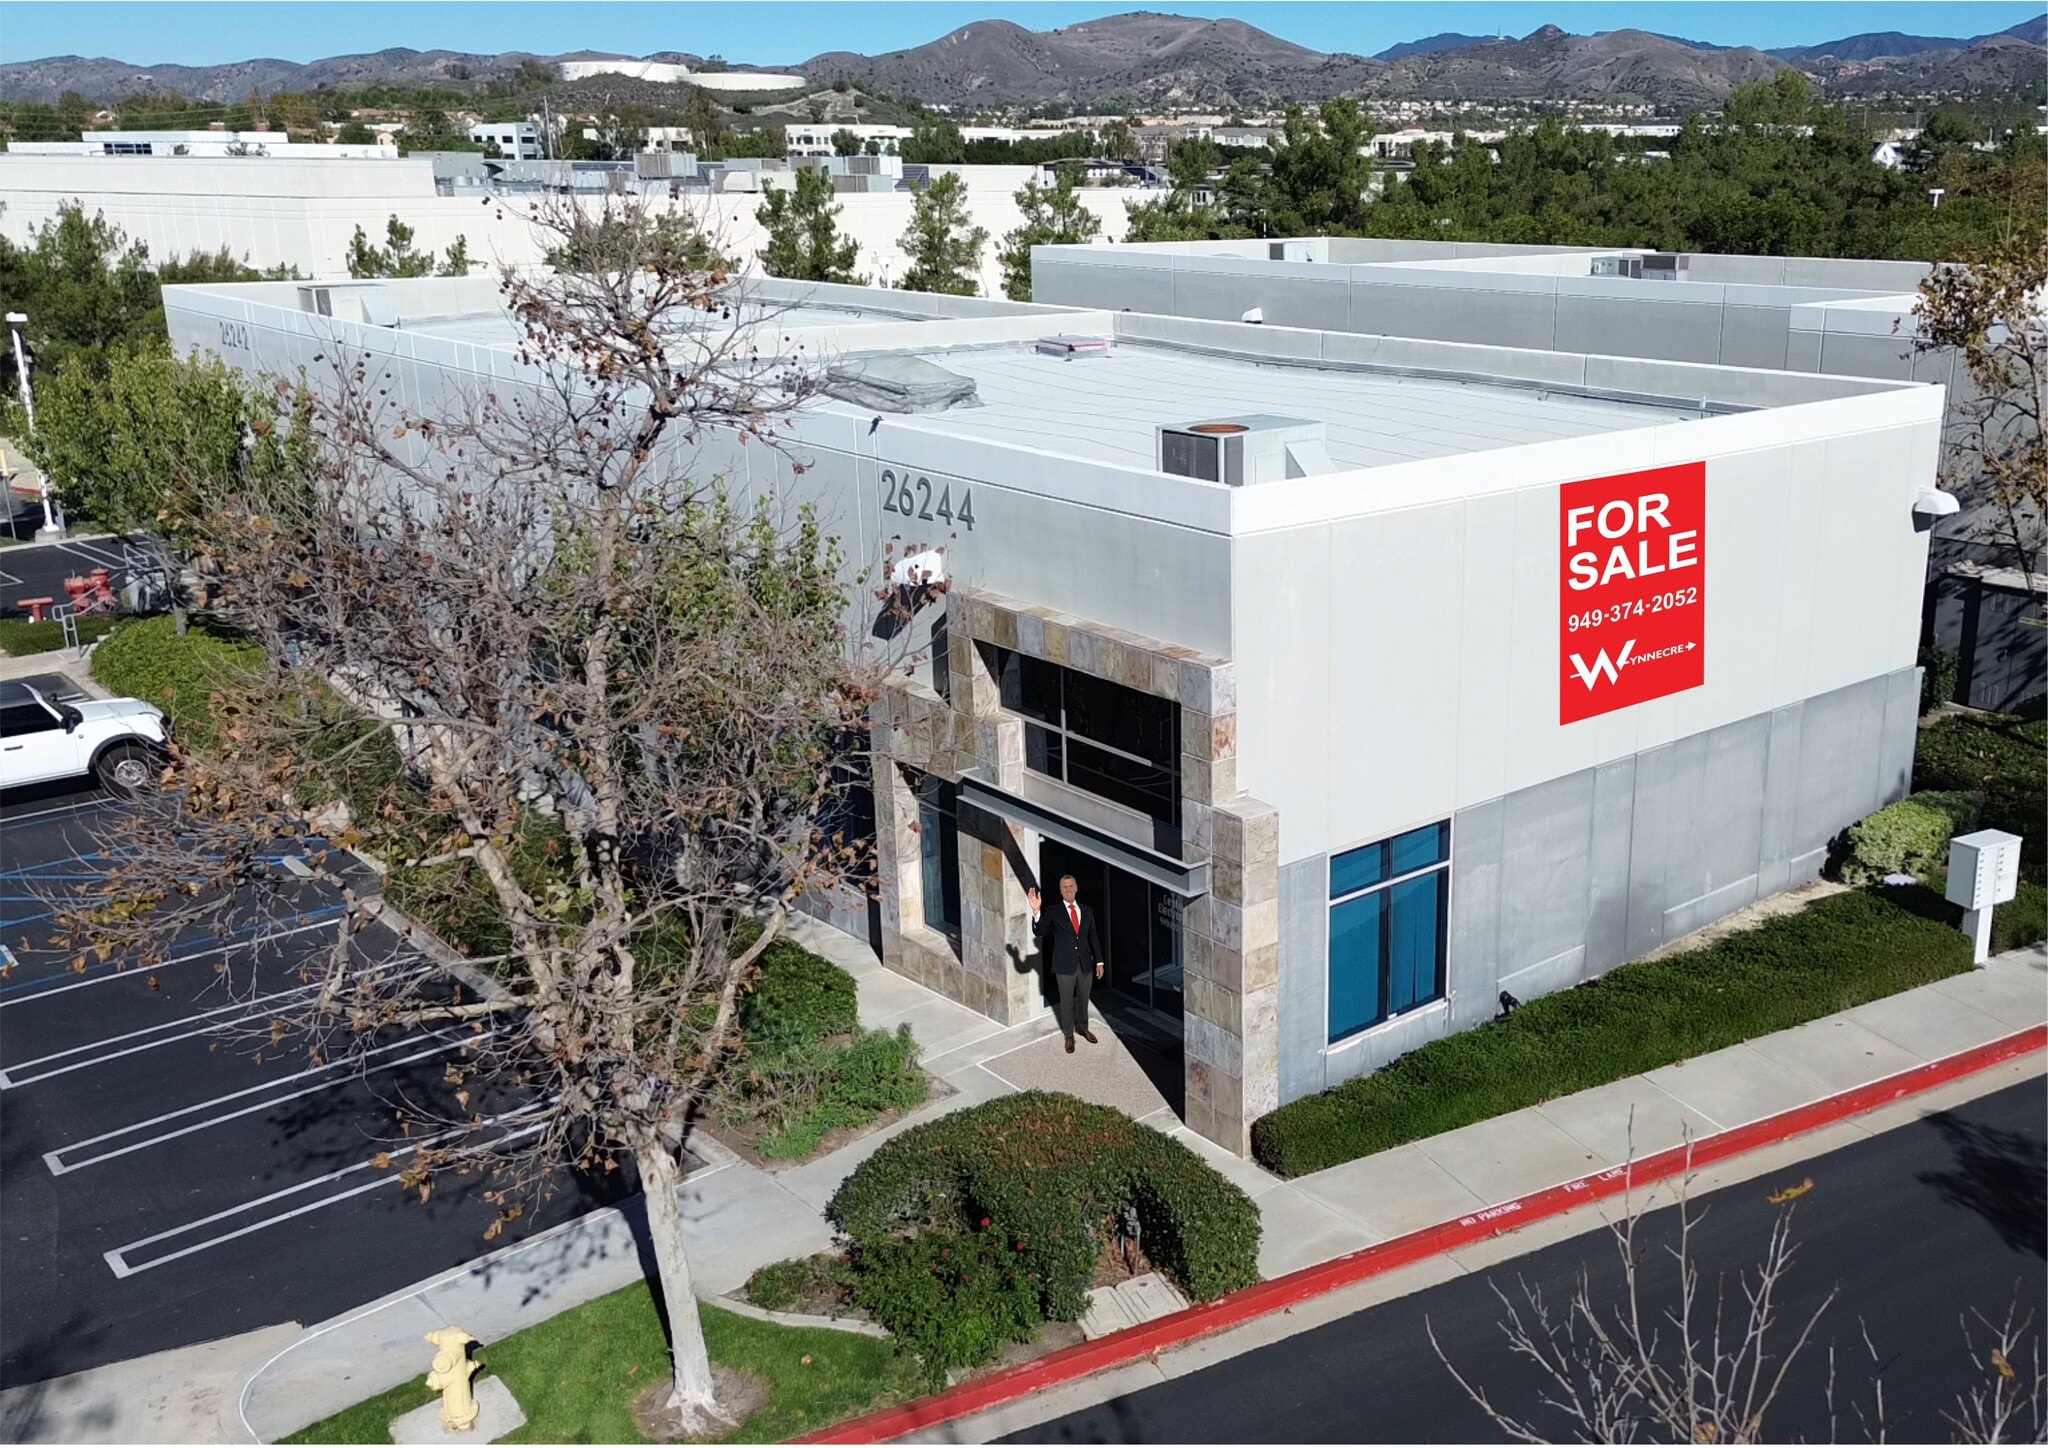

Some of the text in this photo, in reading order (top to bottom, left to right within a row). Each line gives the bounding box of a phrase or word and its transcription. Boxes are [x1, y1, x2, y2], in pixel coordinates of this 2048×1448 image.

[881, 469, 976, 531] 26244
[1567, 493, 1672, 547] FOR
[1567, 529, 1698, 591] SALE
[1568, 587, 1697, 632] 949-374-2052
[1563, 1168, 1627, 1193] FIRE LANE
[1459, 1202, 1523, 1227] NO PARKING
